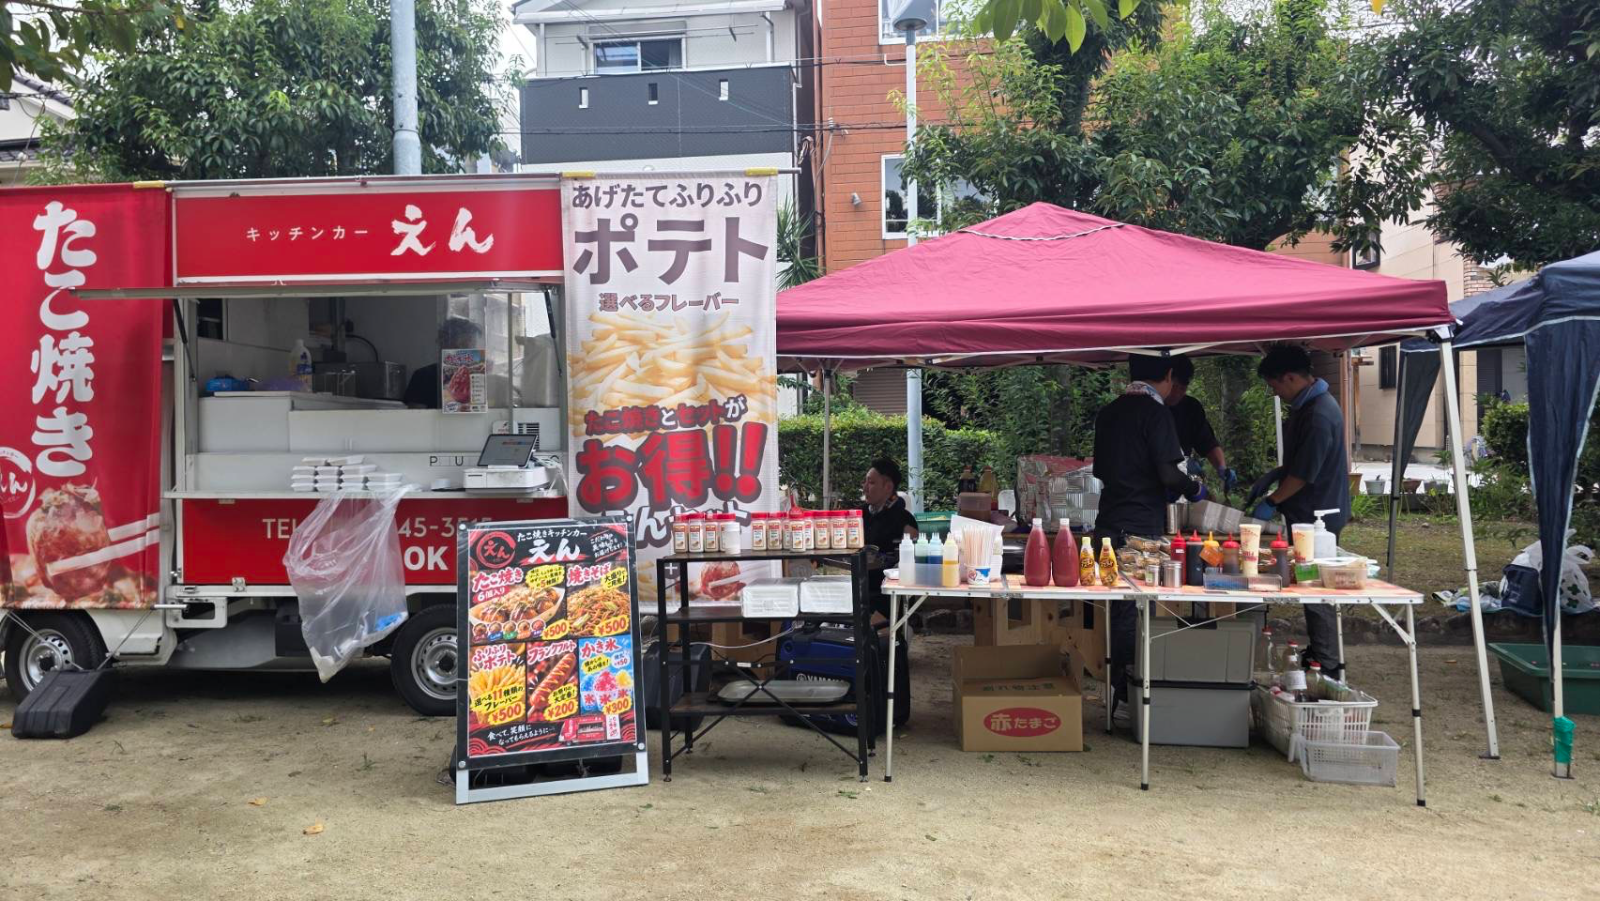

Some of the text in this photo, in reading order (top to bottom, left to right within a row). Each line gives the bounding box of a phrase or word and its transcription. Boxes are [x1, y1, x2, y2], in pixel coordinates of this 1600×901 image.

[572, 181, 763, 209] あげたてふりふり
[246, 203, 495, 257] キッチンカー えん
[572, 212, 769, 286] ポテト
[598, 292, 739, 312] 選べるフレーバー
[30, 200, 97, 477] たこ焼き
[584, 394, 748, 436] たこ焼きとセットが
[517, 529, 587, 542] たこ焼きキッチンカー
[403, 546, 449, 571] OK
[484, 540, 510, 559] えん
[527, 538, 581, 563] えん
[473, 568, 523, 592] たこ焼き
[567, 563, 611, 586] 焼きそば
[545, 621, 567, 638] ¥500
[598, 618, 628, 636] ¥500
[528, 640, 577, 665] フランクフルト
[581, 638, 620, 659] かき氷
[482, 653, 517, 671] ポテト
[491, 703, 522, 722] ¥500
[547, 701, 575, 719] ¥200
[605, 700, 630, 714] ¥300
[990, 713, 1058, 731] 赤たまご
